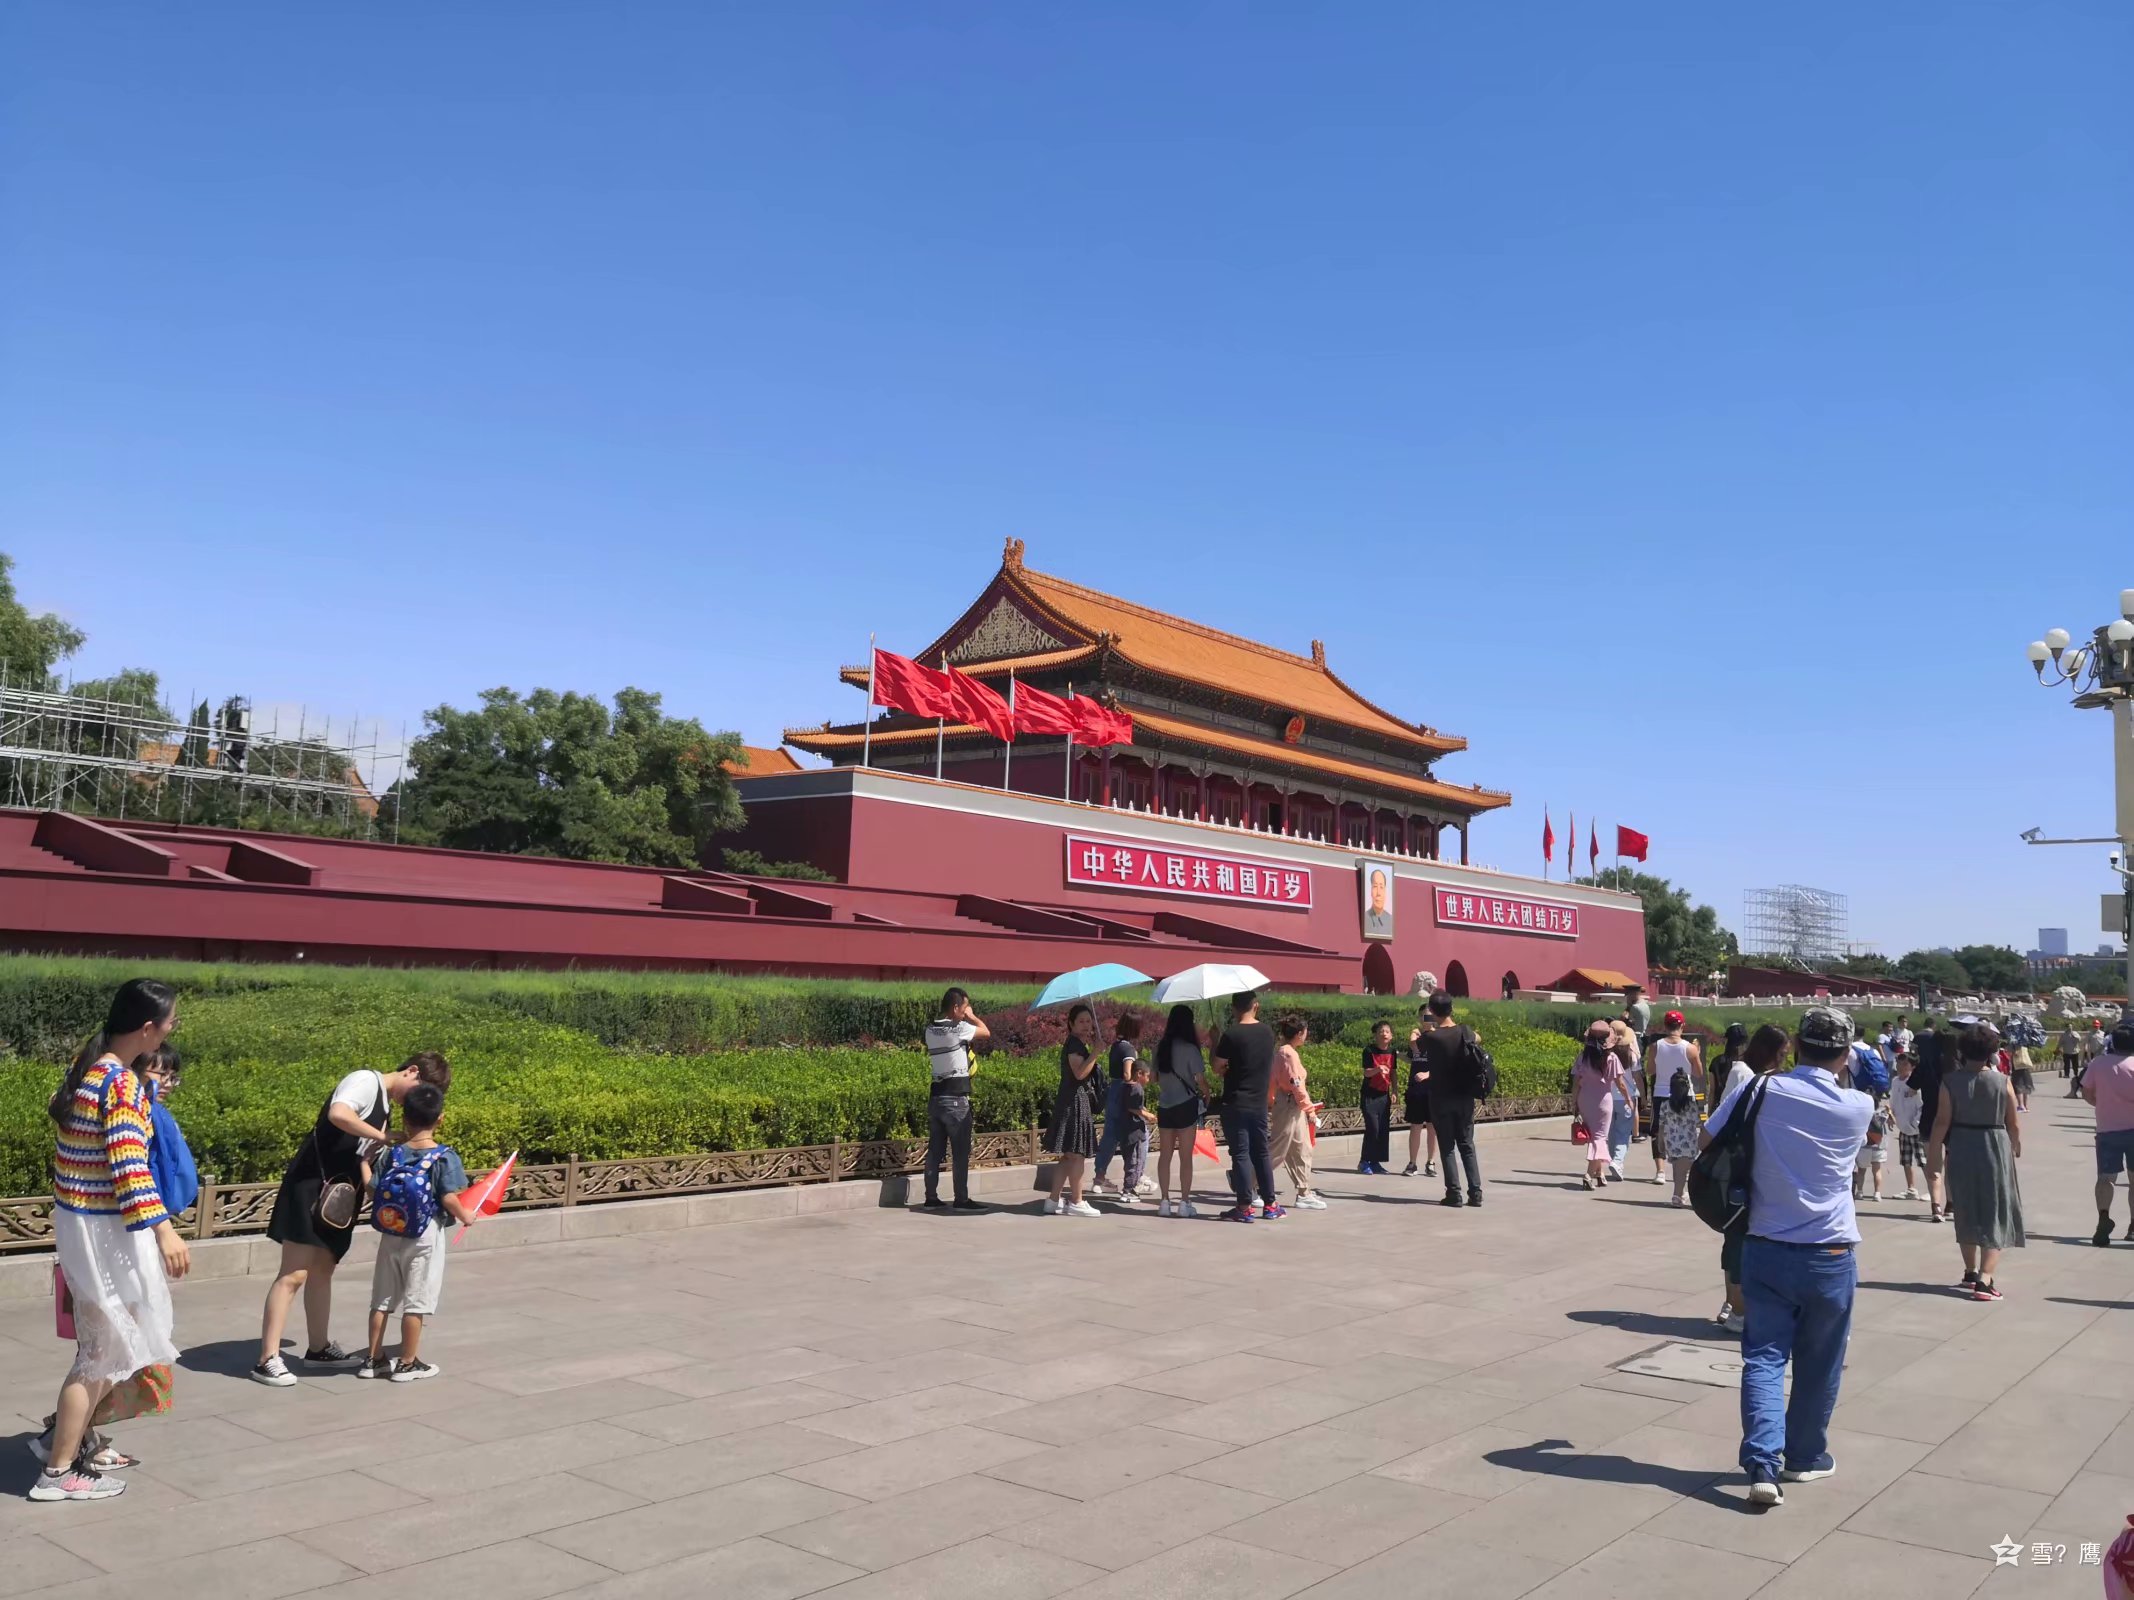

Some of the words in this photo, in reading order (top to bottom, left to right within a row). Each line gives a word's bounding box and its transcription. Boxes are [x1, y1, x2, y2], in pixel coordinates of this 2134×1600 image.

[1083, 845, 1301, 899] 中华人民共和国万岁
[1445, 894, 1572, 931] 世界人民大团结万岁
